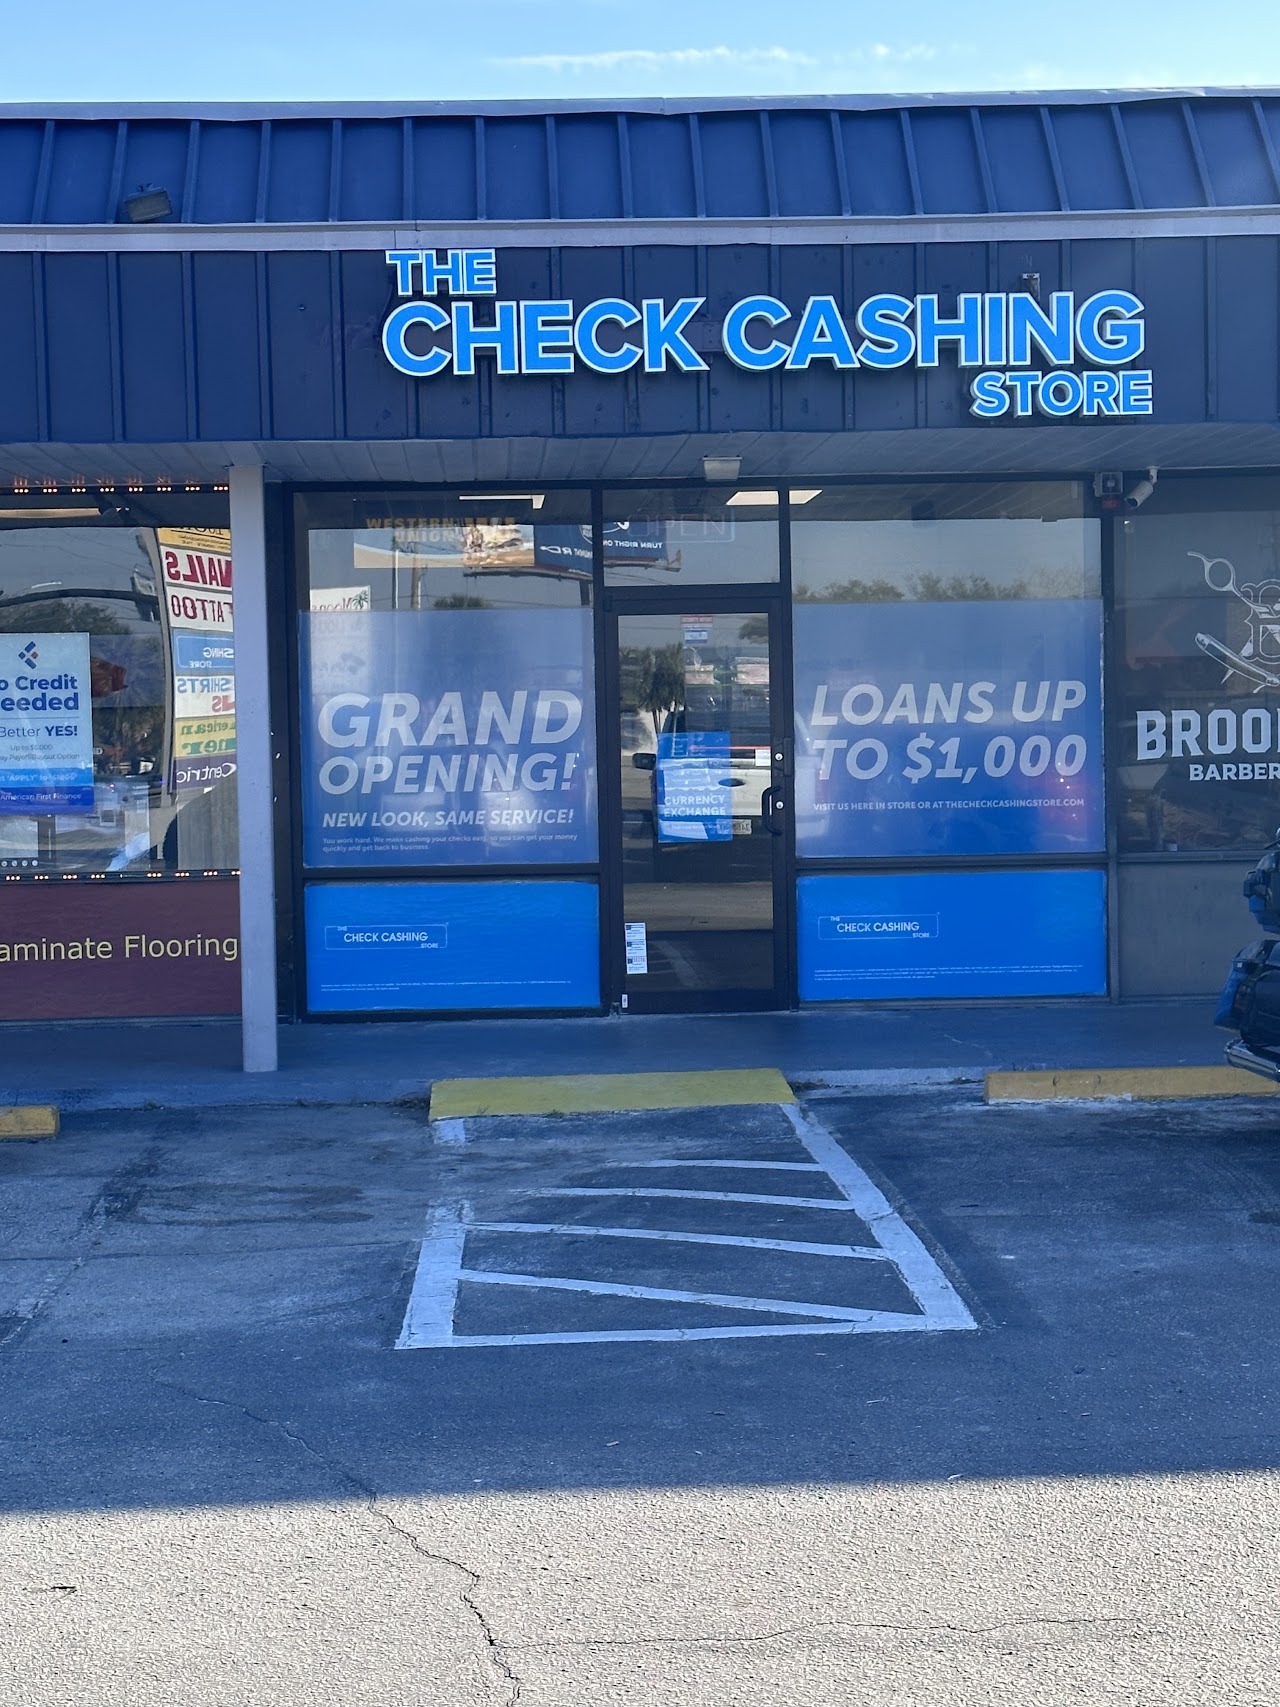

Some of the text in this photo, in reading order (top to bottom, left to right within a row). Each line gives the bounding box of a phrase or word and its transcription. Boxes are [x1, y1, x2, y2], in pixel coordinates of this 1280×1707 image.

[386, 248, 497, 296] THE
[382, 290, 1145, 377] CHECK CASHING
[971, 369, 1153, 417] STORE
[366, 517, 454, 529] WESTERN
[394, 530, 453, 542] UNION
[15, 673, 78, 690] Credit
[0, 692, 79, 711] eeded
[810, 680, 1087, 726] LOANS UP
[318, 690, 583, 748] GRAND
[45, 725, 78, 737] YES!
[1136, 708, 1280, 760] BROO
[812, 732, 1088, 784] TO $1,000
[319, 752, 577, 795] OPENING!
[664, 794, 726, 805] CURRENCY
[813, 798, 1085, 811] VISIT US HERE IN STORE OR AT THECHECKCASHINGSTORE.COM
[322, 808, 575, 828] NEW LOOK, SAME SERVICE!
[664, 806, 726, 817] EXCHANGE
[322, 845, 347, 853] quickly
[405, 836, 430, 844] cashing
[431, 836, 447, 844] your
[836, 921, 920, 933] CHECK CASHING
[343, 932, 429, 943] CHECK CASHING
[0, 934, 238, 961] aminate Flooring
